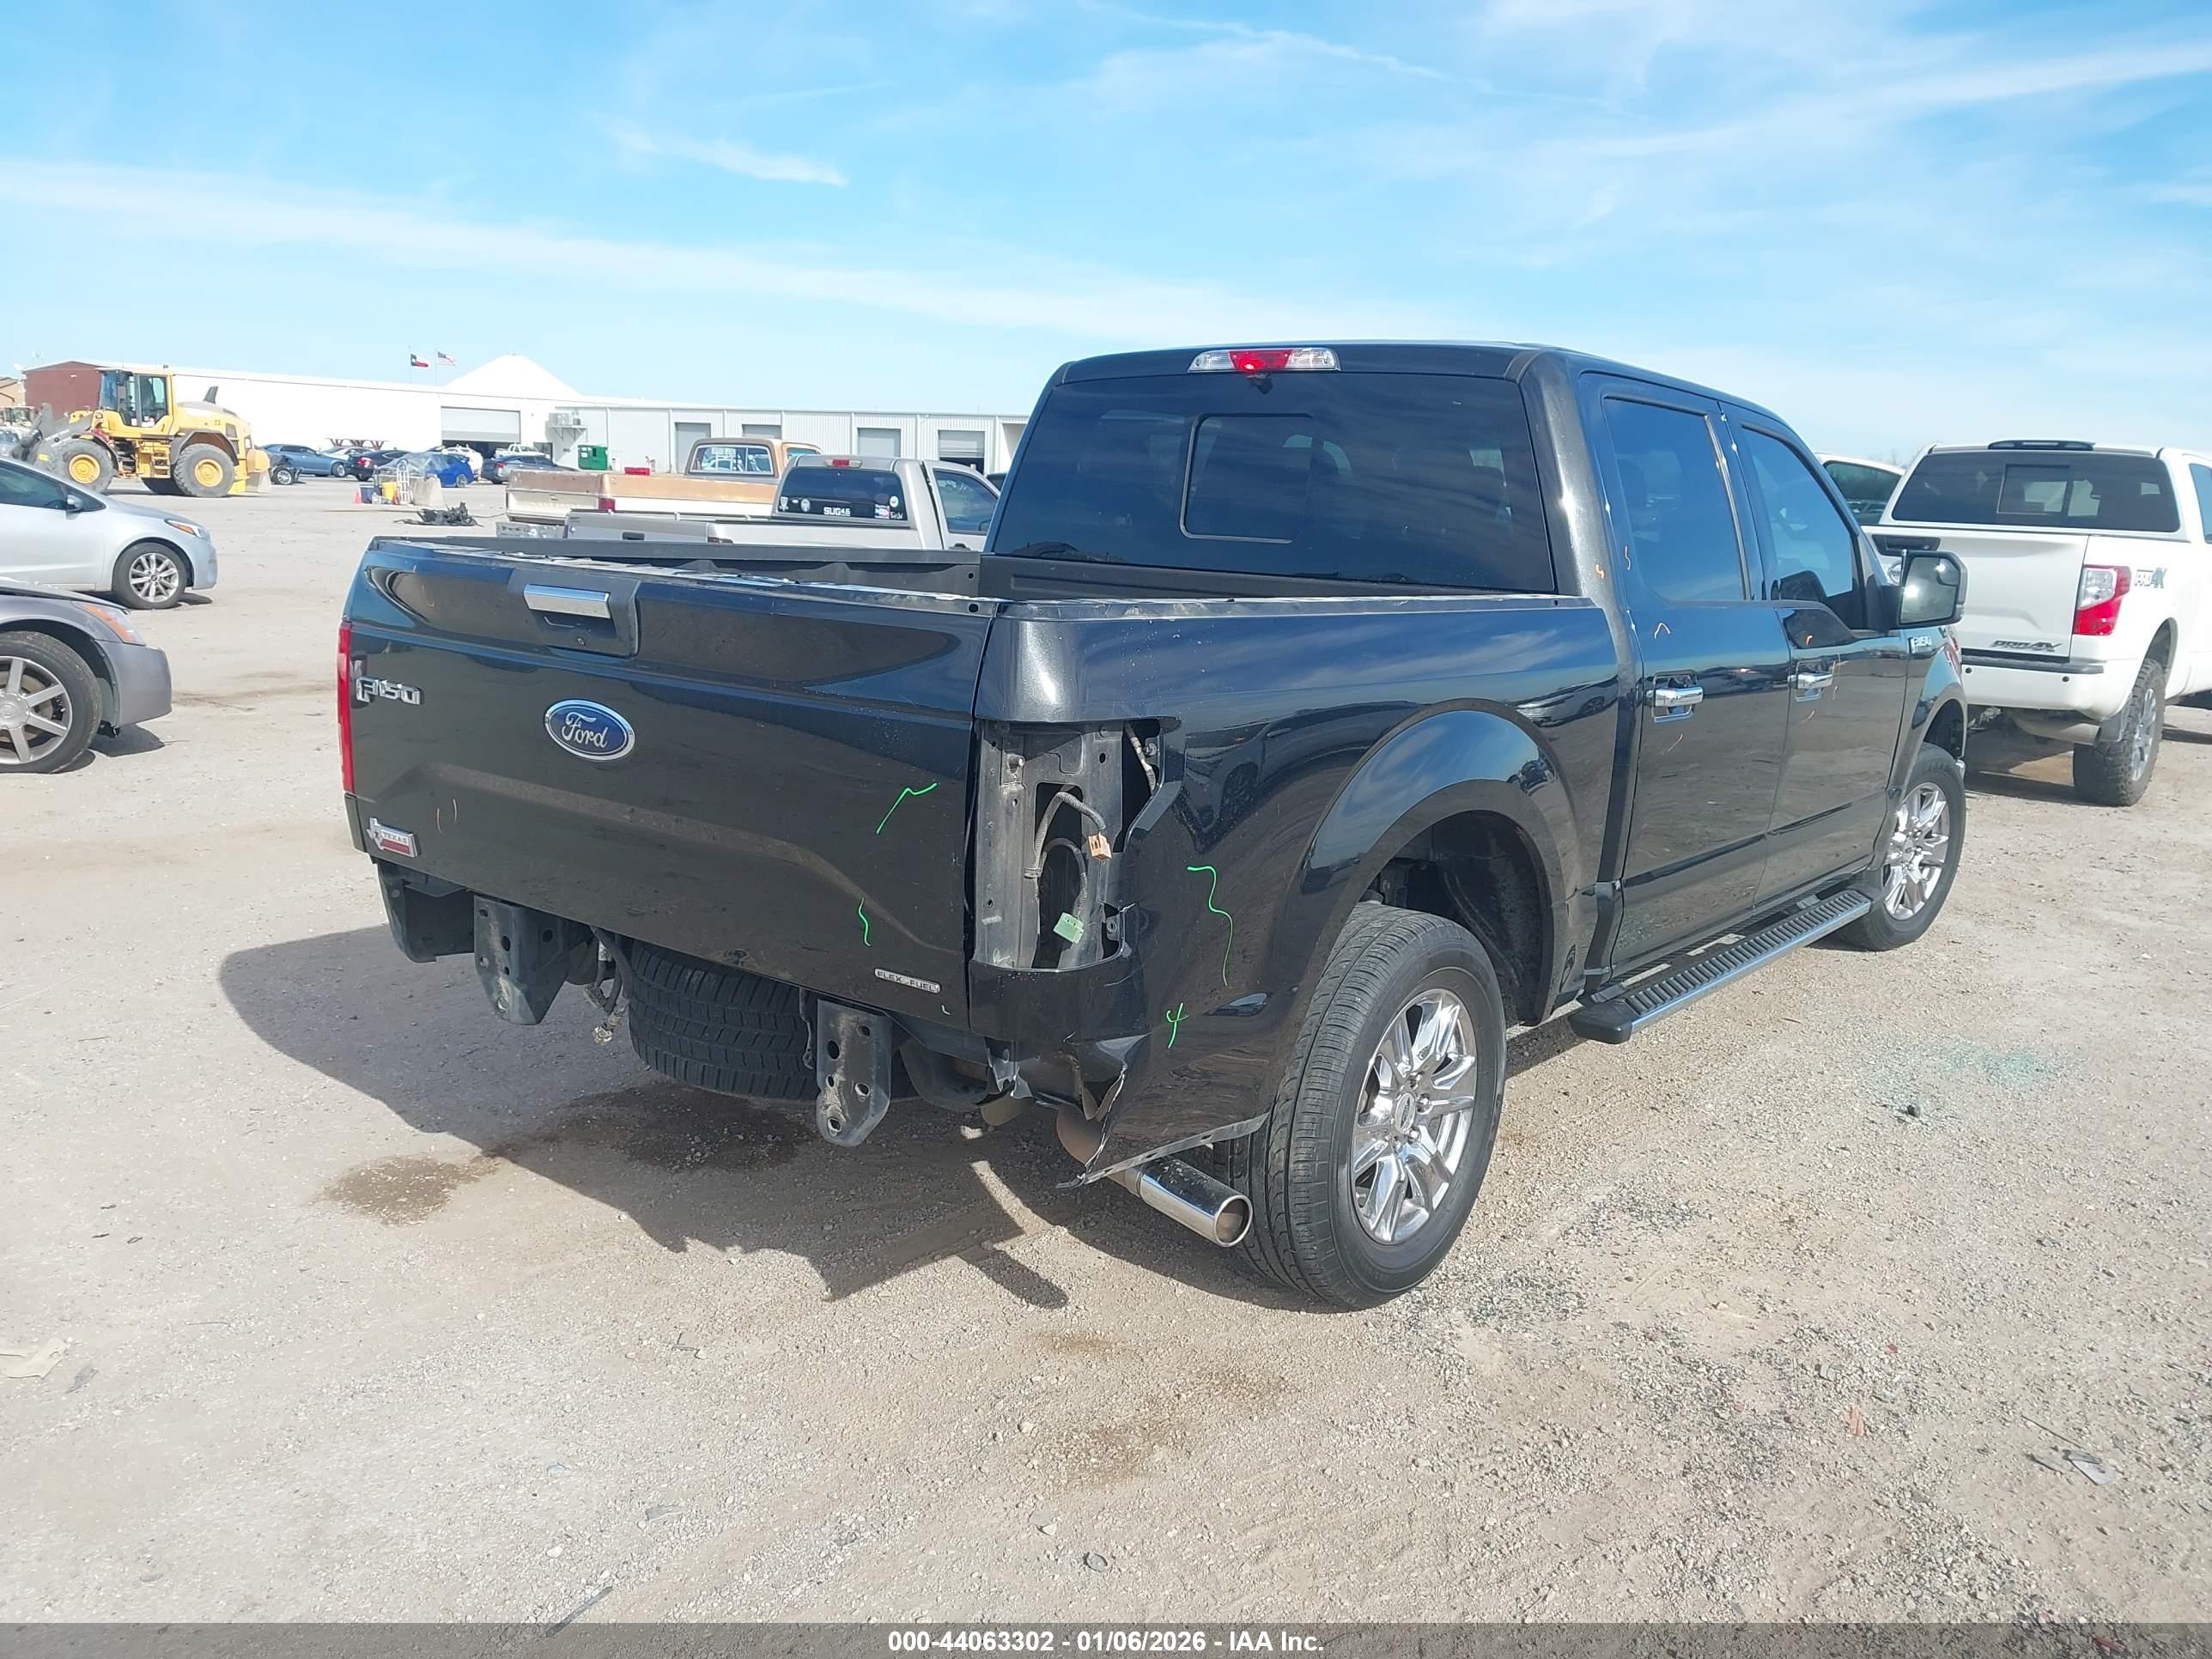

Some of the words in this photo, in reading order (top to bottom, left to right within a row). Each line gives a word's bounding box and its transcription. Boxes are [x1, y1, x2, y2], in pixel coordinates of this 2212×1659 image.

[562, 711, 609, 748] Ford
[877, 970, 902, 982] FLEX
[910, 979, 935, 993] FUEL
